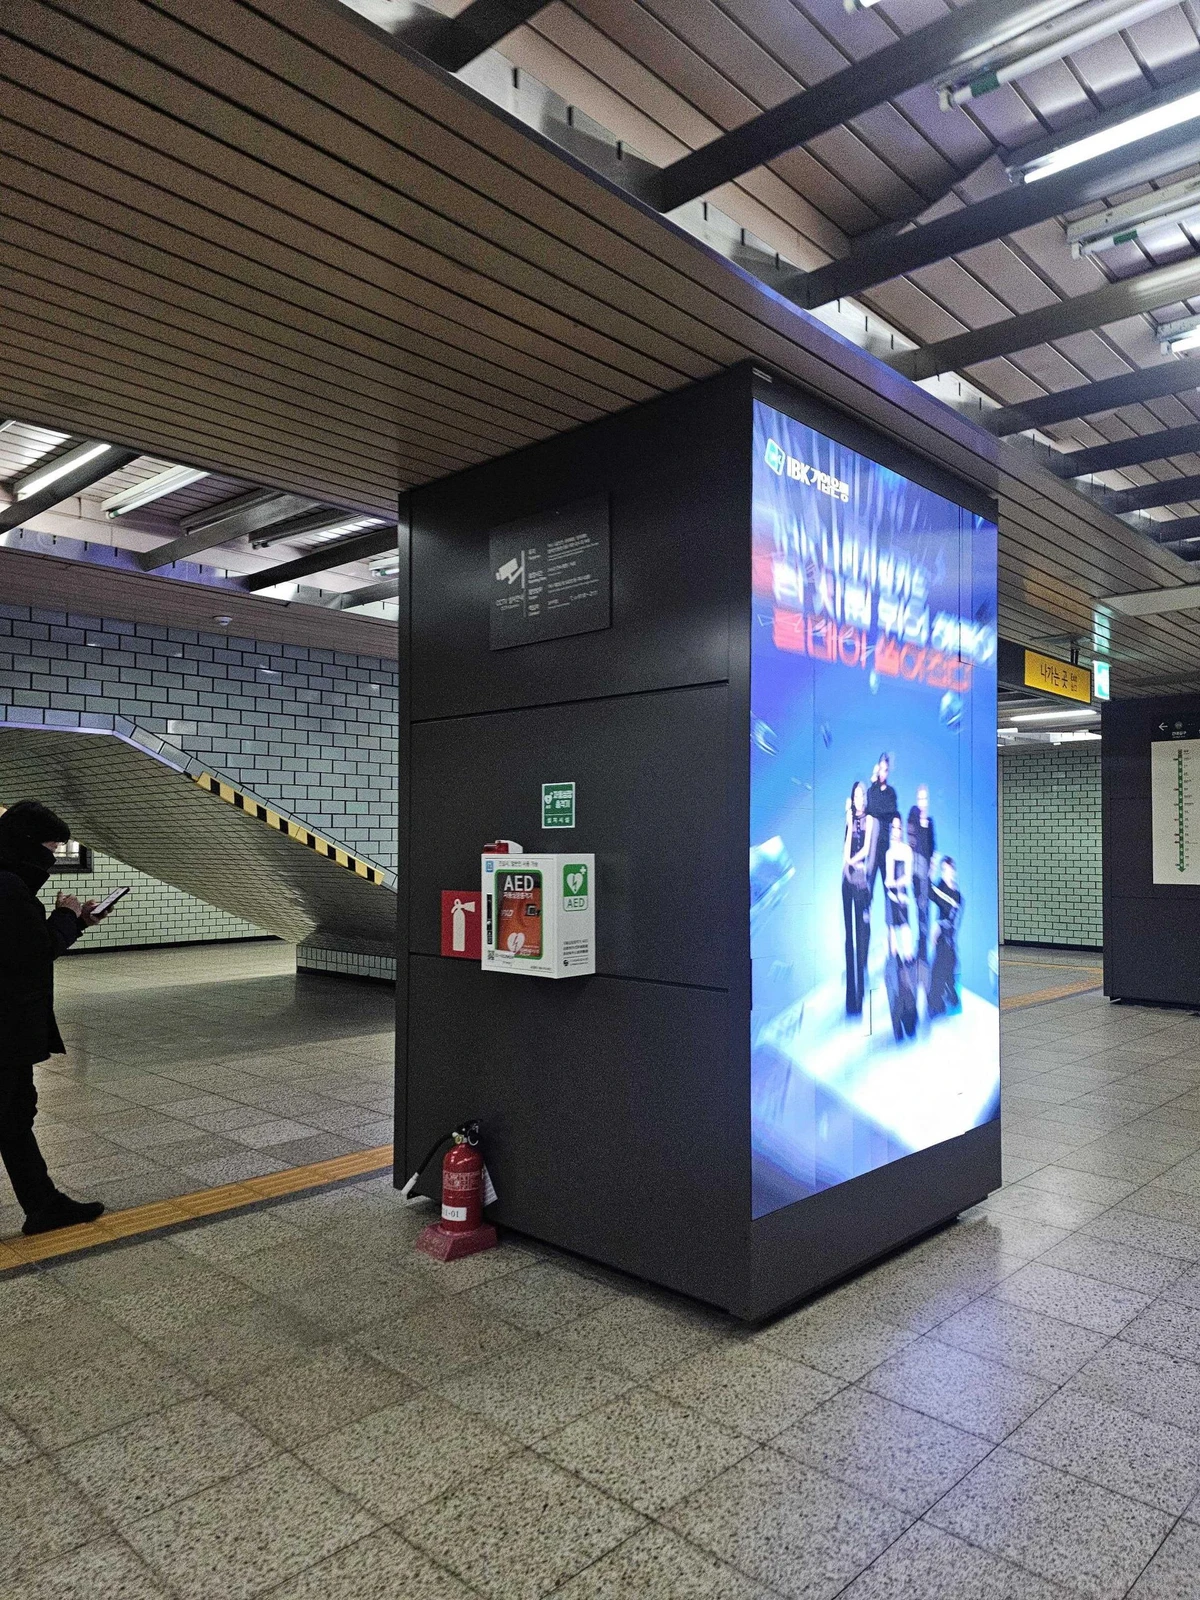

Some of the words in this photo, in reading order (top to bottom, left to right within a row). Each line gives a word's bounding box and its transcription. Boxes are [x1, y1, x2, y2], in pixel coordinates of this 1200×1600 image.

[786, 455, 850, 503] IBK기업은행
[1040, 663, 1061, 687] 나가는
[1061, 670, 1069, 689] 곳
[504, 875, 534, 891] AED
[567, 897, 586, 909] AED
